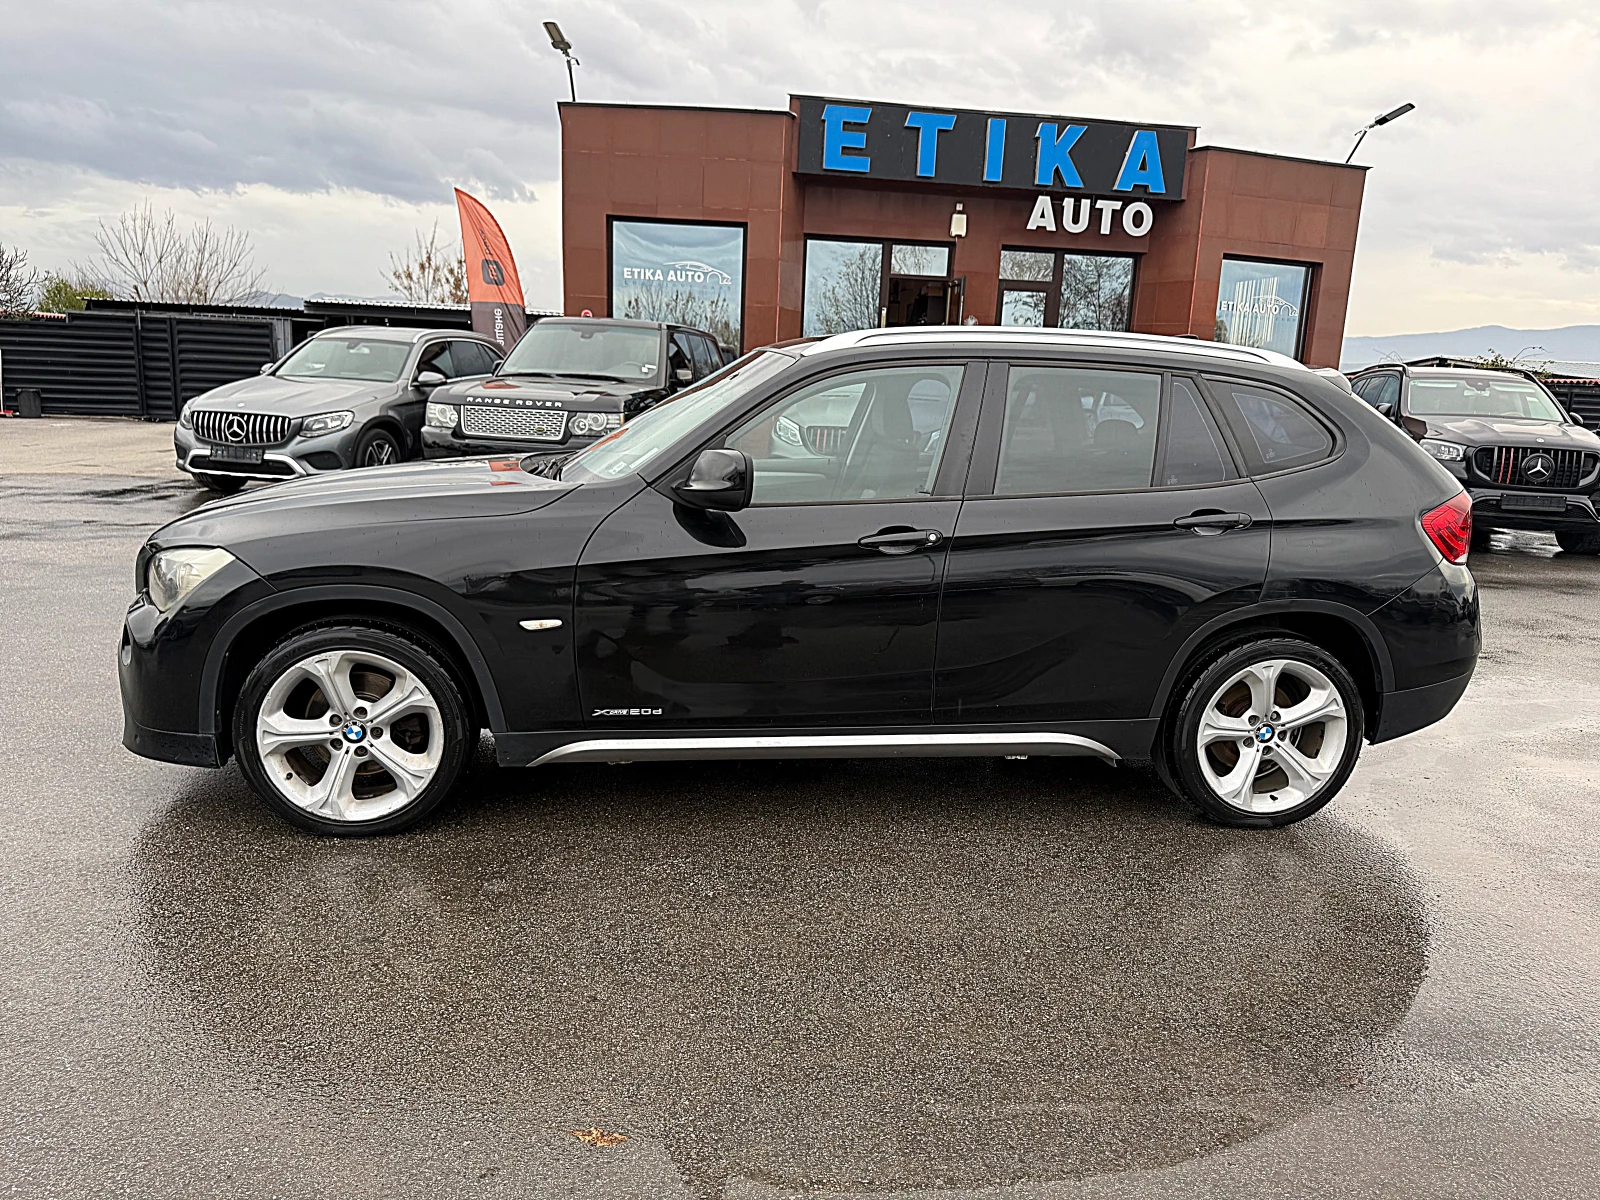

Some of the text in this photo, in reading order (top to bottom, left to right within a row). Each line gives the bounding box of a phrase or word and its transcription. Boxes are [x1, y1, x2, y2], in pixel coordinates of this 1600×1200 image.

[822, 104, 1166, 194] ETIKA
[1026, 195, 1154, 237] AUTO
[623, 267, 705, 283] ETIKA AUTO
[1221, 300, 1280, 315] ETIKA AUTO
[466, 396, 563, 408] RANGE ROVER
